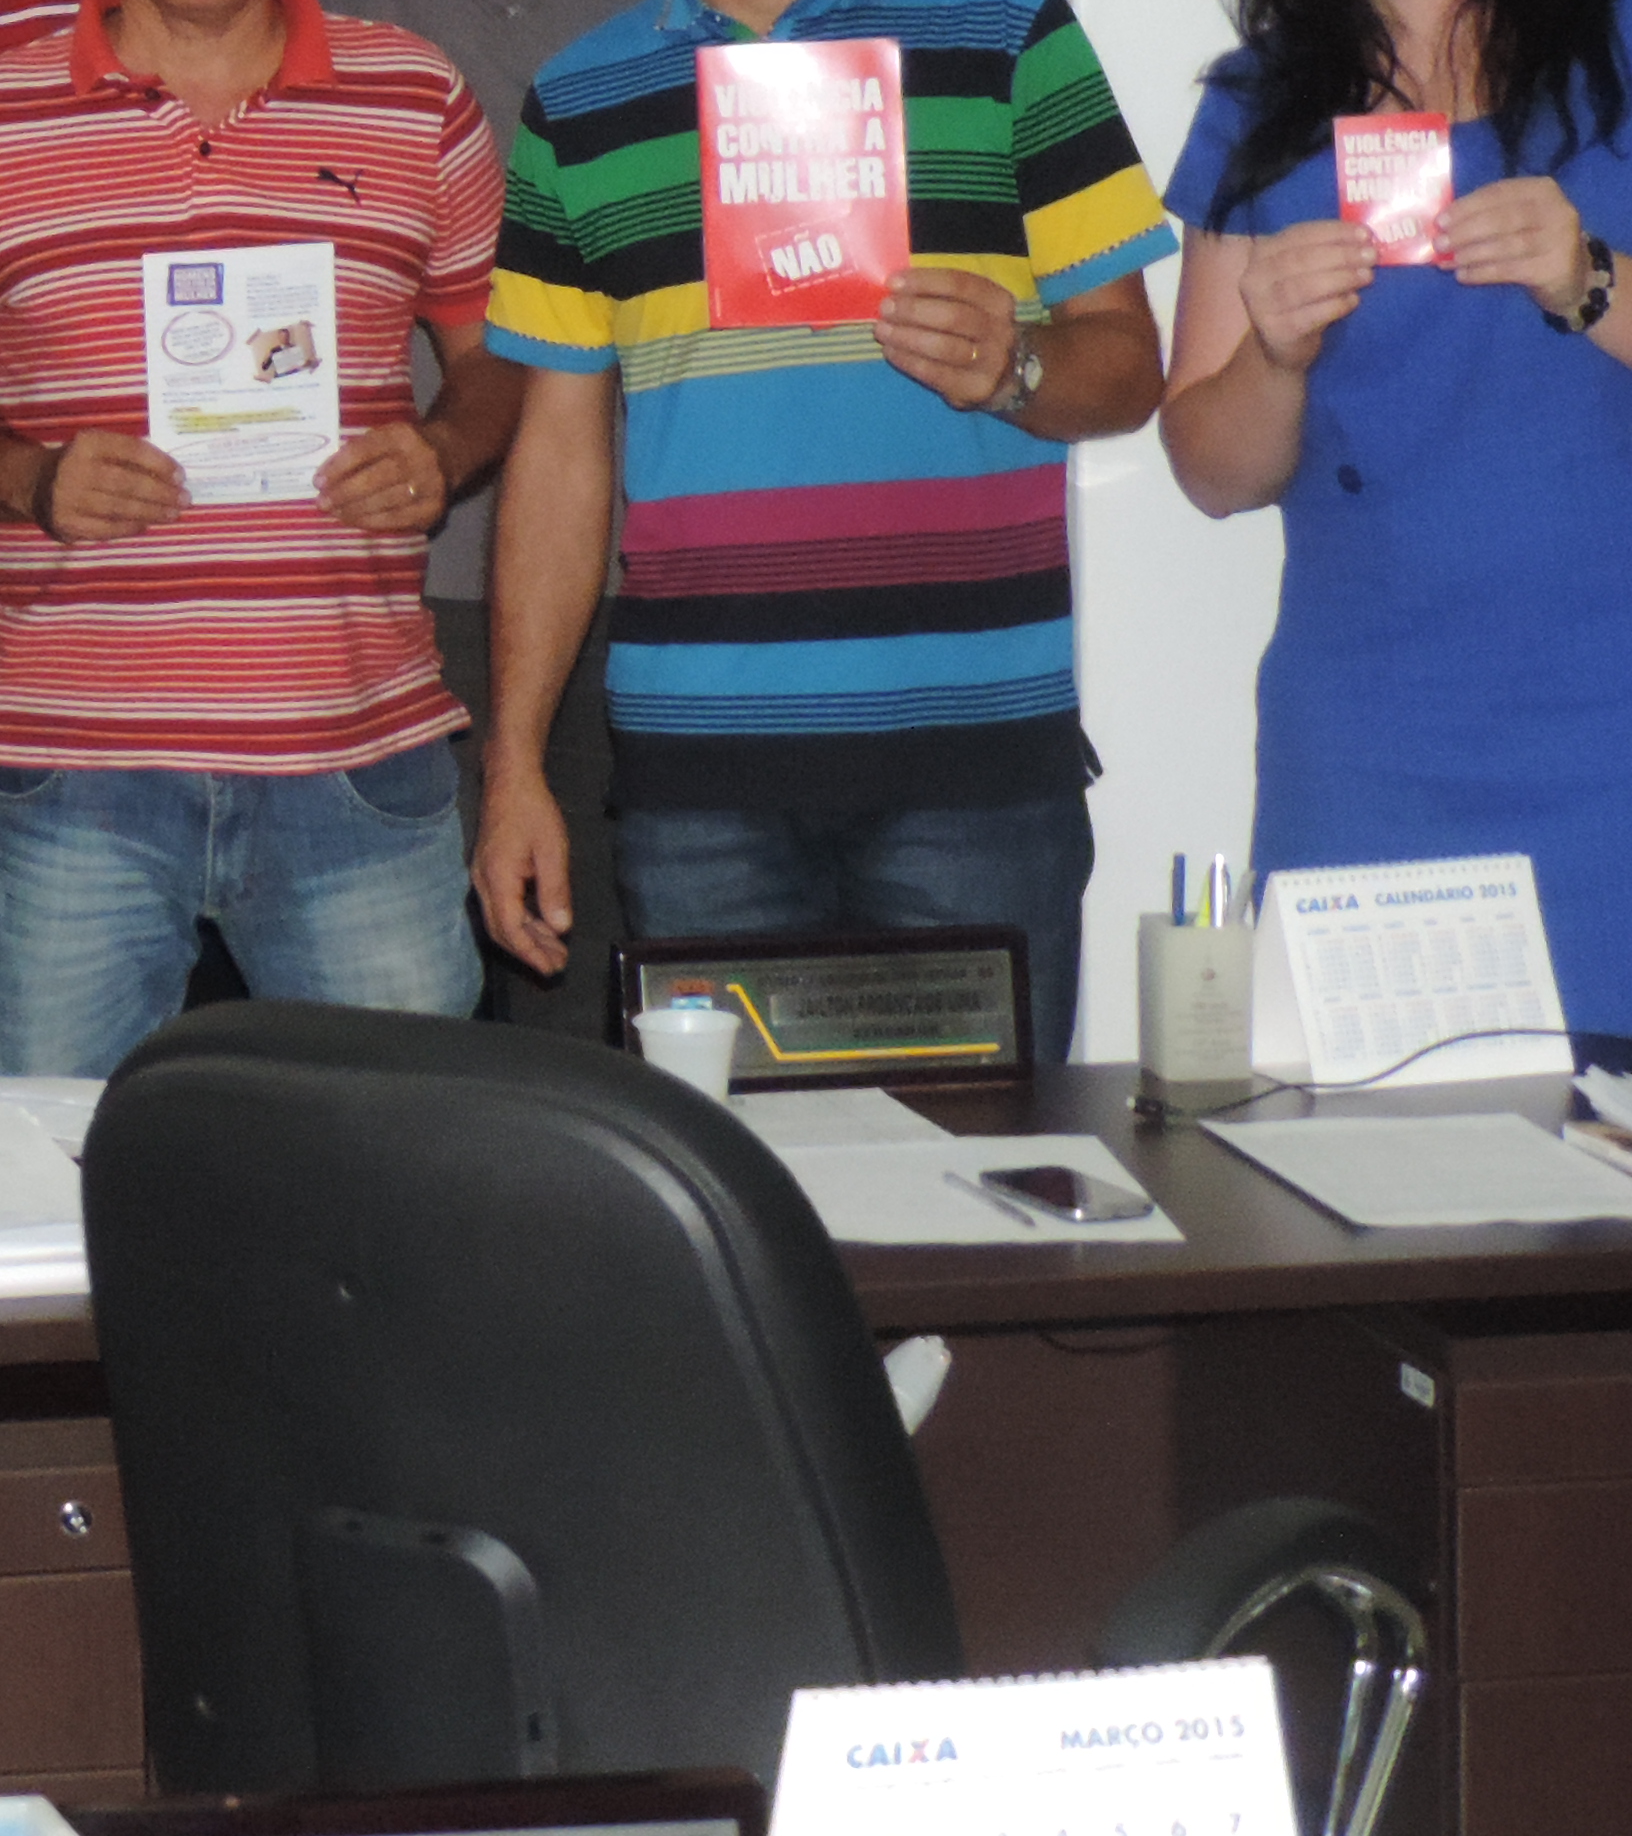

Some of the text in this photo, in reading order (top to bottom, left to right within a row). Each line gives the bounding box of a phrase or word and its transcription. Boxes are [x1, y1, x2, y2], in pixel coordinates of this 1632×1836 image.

[864, 117, 885, 151] A
[1343, 128, 1438, 154] VIOLÊNCIA
[719, 157, 886, 204] MULHER
[770, 230, 843, 281] NÃO
[1296, 894, 1359, 914] CAIXA
[1479, 882, 1517, 899] 2015
[1061, 1714, 1245, 1750] MARÇO 2015
[847, 1736, 957, 1769] CAIXA
